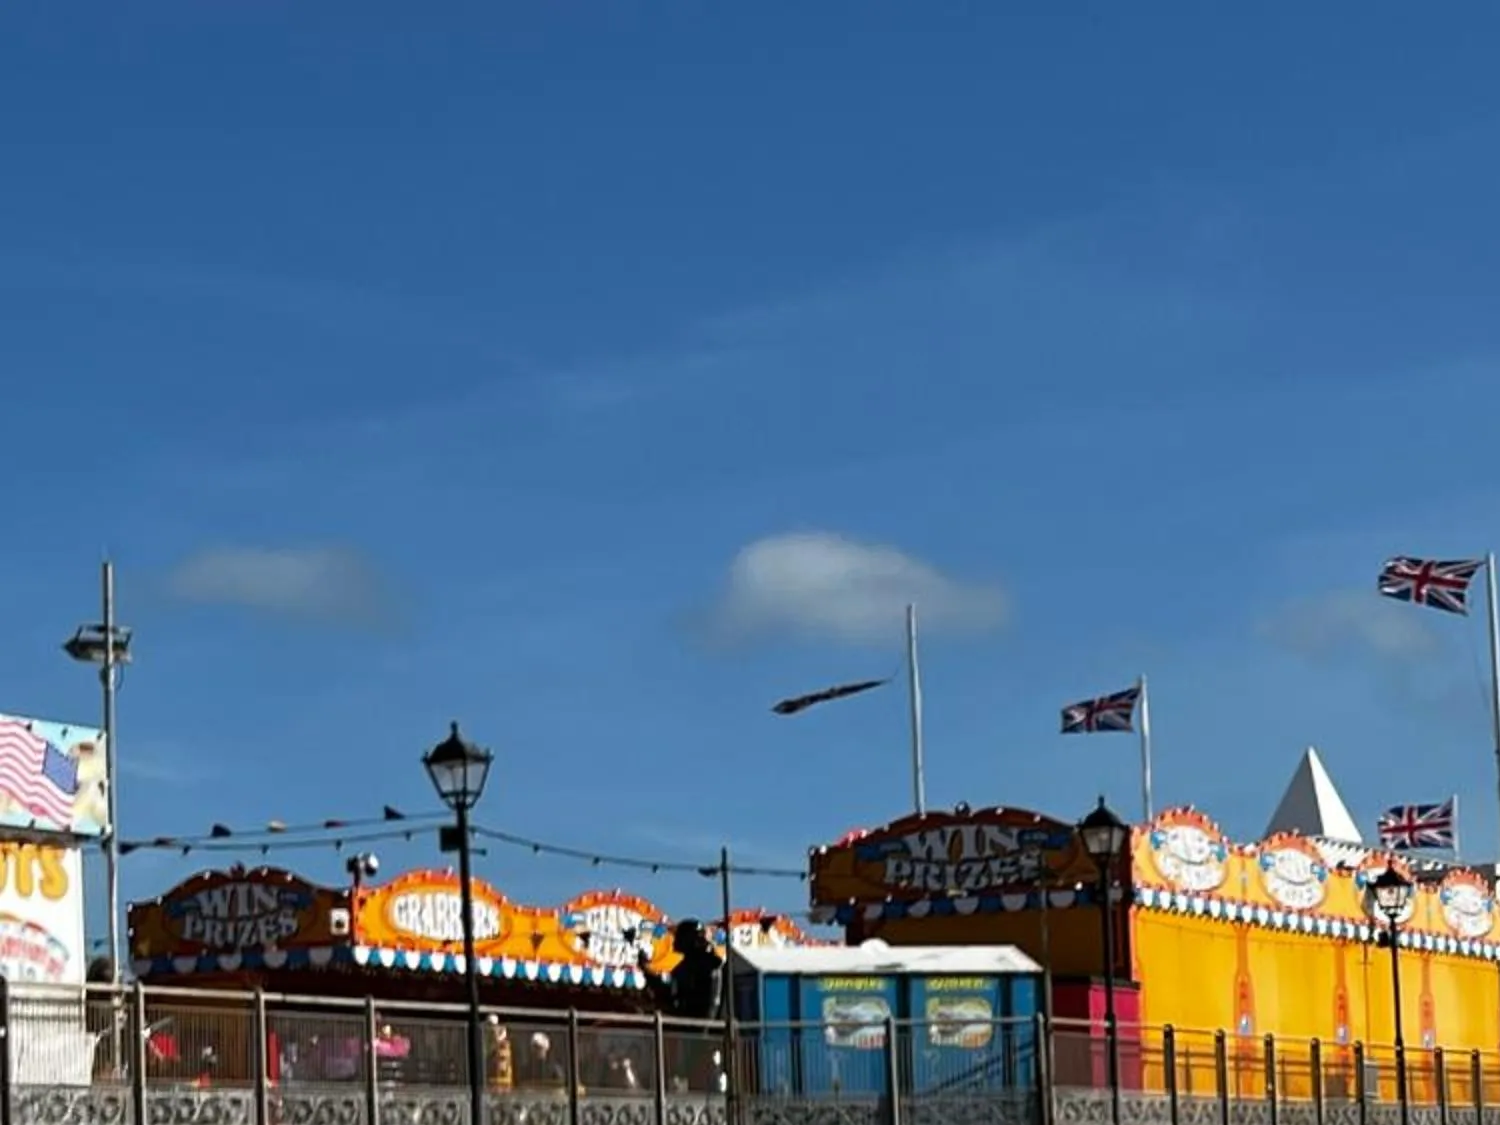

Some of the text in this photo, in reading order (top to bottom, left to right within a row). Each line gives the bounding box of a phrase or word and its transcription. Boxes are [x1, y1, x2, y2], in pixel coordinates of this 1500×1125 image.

[902, 825, 1019, 860] WIN
[0, 841, 69, 899] TS
[883, 848, 1041, 891] PRIZES
[195, 882, 280, 917] WIN
[394, 892, 501, 940] GRABBRS
[181, 907, 299, 949] PRIZES
